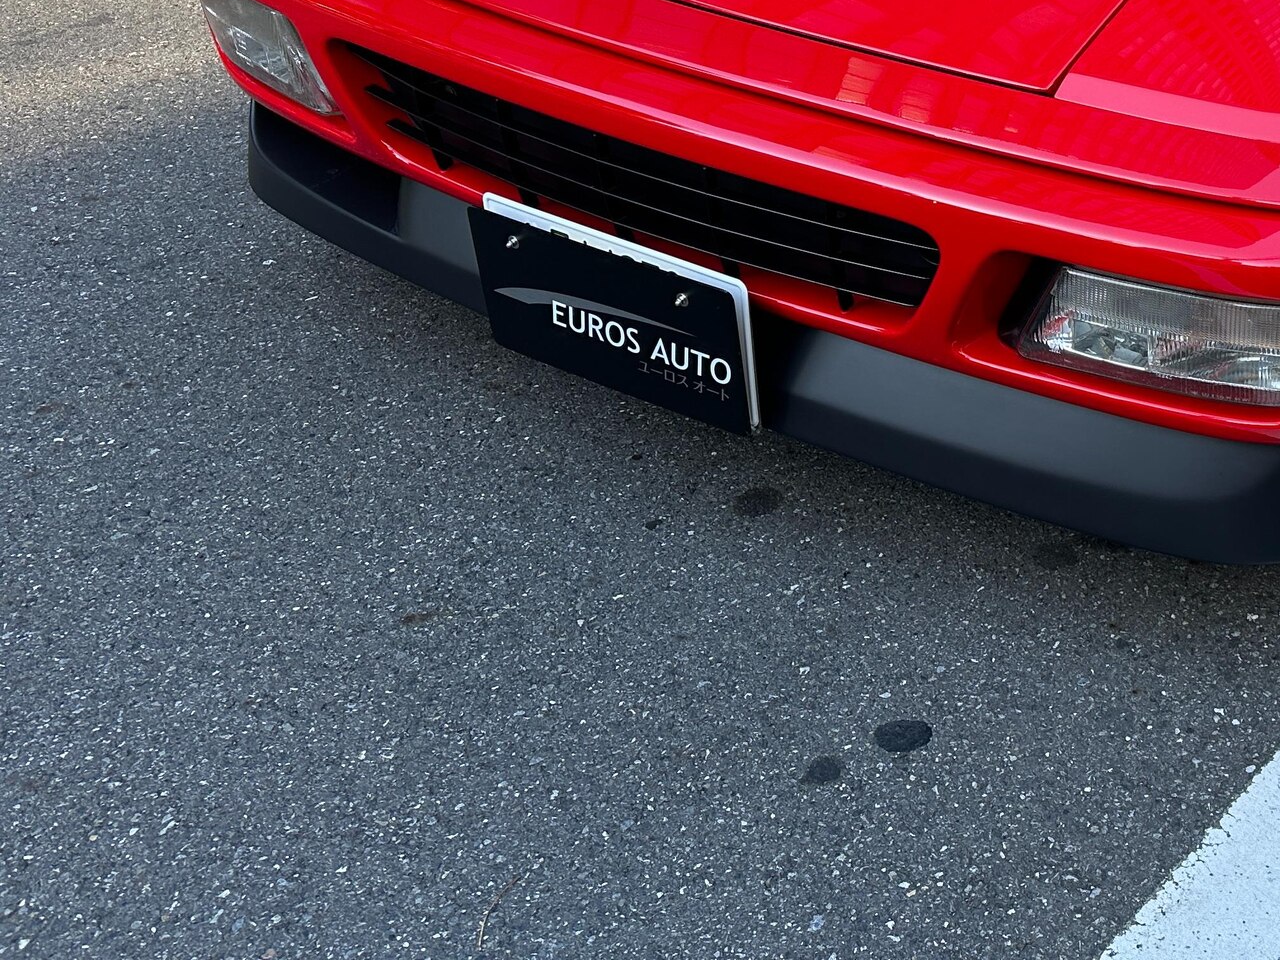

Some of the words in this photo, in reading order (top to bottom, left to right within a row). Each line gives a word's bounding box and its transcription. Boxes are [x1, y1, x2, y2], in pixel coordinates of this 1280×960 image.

[552, 300, 640, 354] EUROS
[650, 337, 731, 385] AUTO
[637, 360, 689, 388] ユーロス
[692, 381, 730, 401] オート
